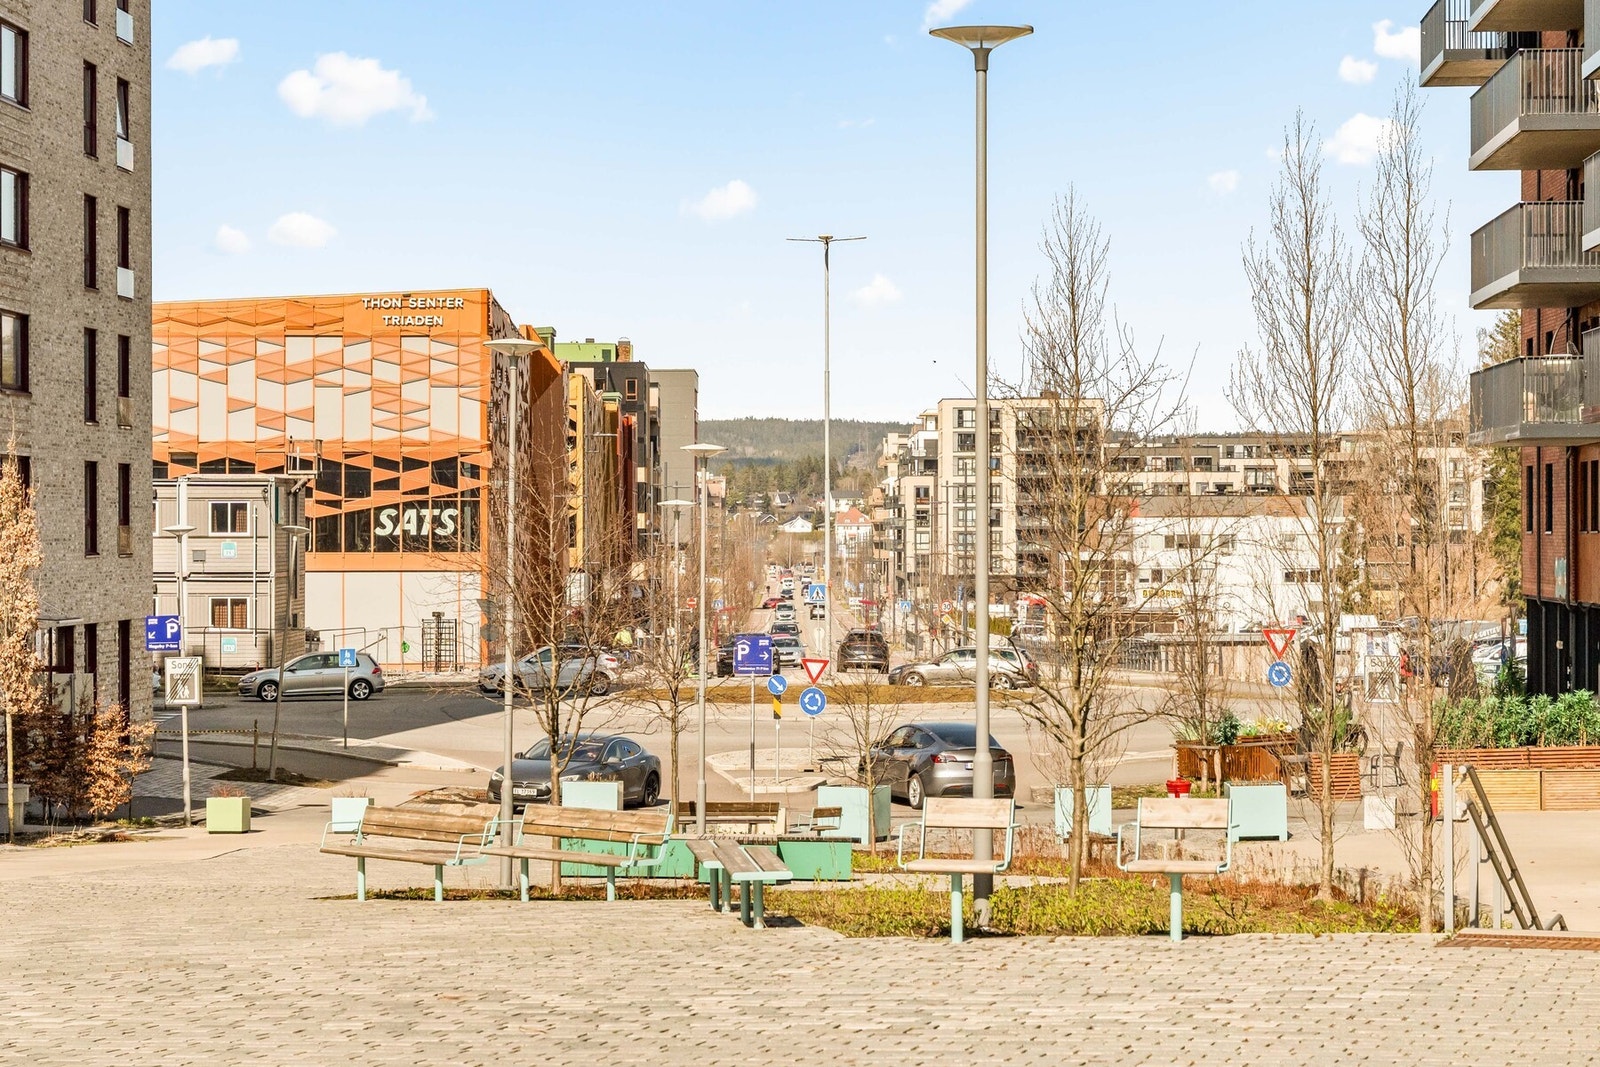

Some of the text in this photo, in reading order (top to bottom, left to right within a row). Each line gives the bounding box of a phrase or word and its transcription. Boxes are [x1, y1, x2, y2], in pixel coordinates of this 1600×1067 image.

[362, 297, 464, 309] THON SENTER
[383, 315, 443, 326] TRIADEN
[374, 508, 459, 536] SATS
[166, 622, 178, 639] P
[737, 644, 750, 661] P
